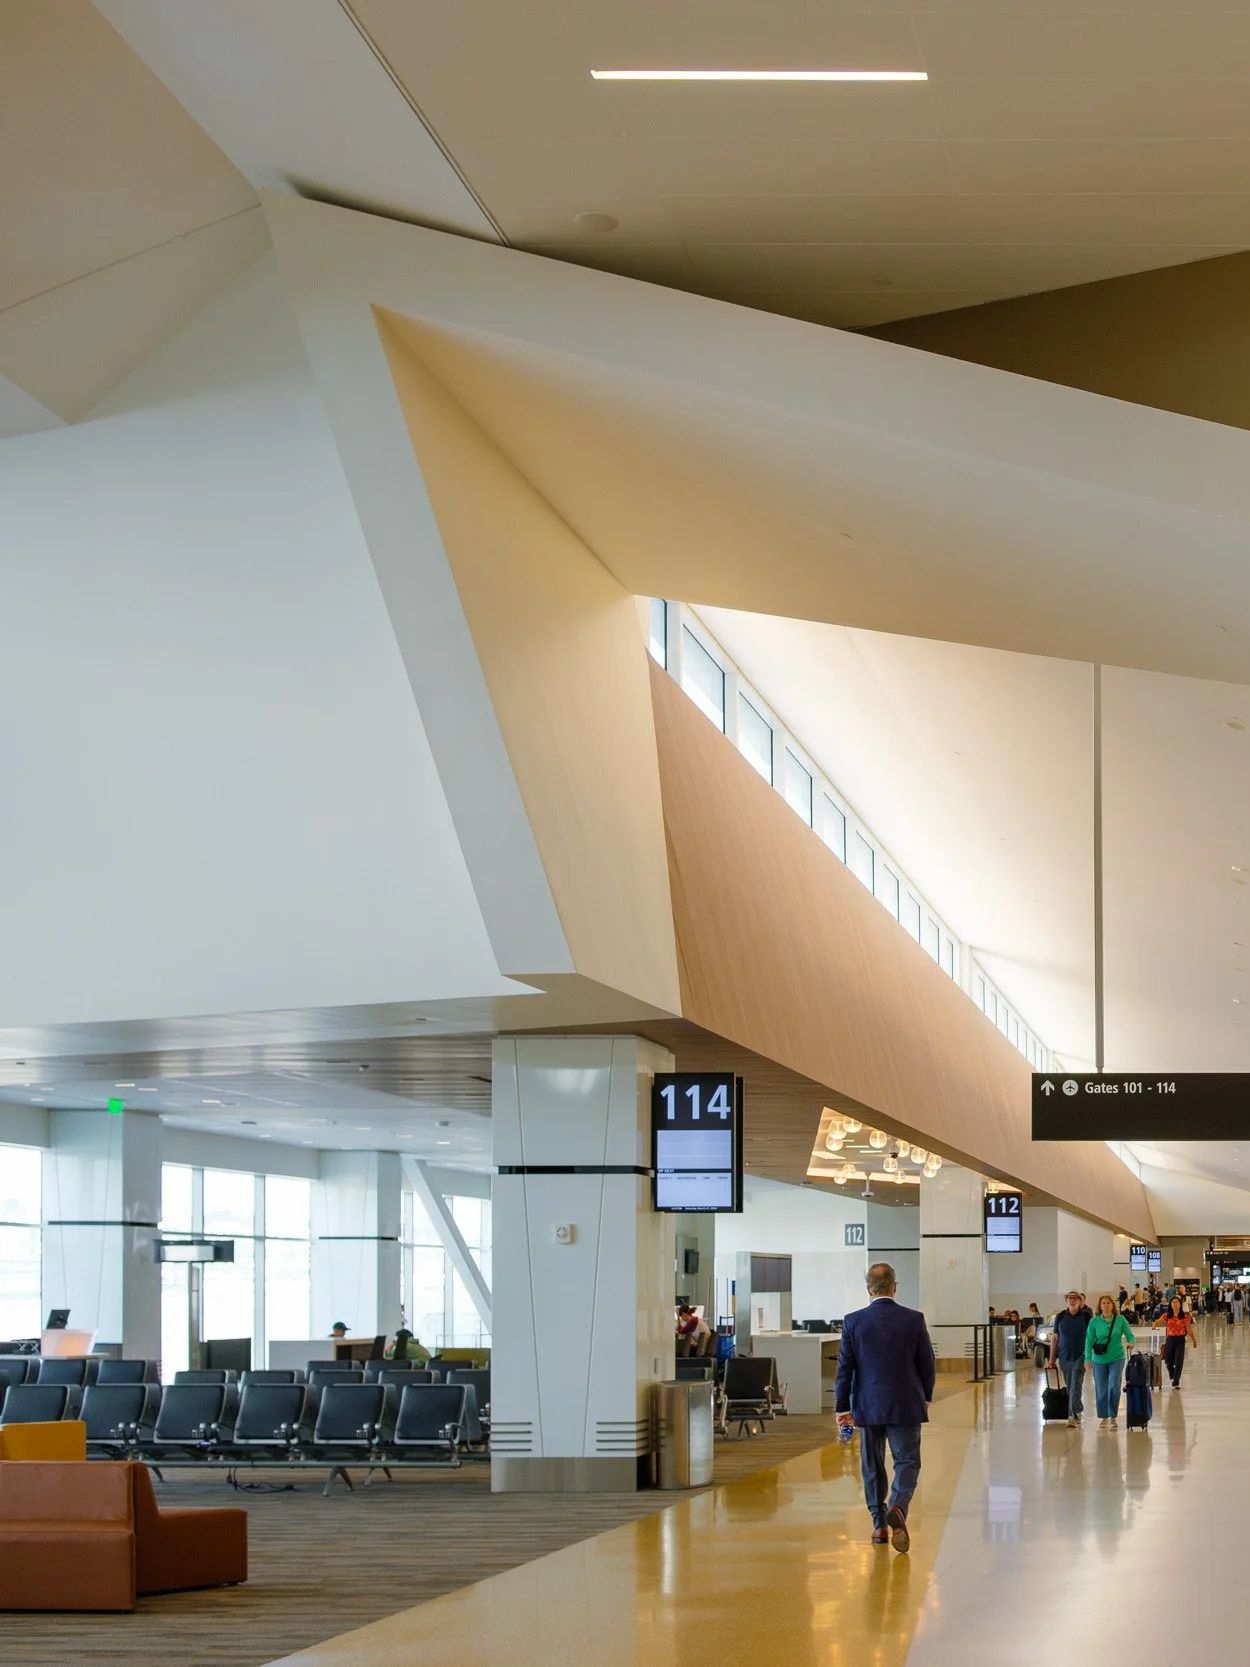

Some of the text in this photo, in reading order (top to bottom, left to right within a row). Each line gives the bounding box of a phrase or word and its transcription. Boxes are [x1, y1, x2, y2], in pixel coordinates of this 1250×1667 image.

[1084, 1081, 1119, 1094] Gates
[1123, 1081, 1142, 1094] 101
[1156, 1081, 1177, 1094] 114
[660, 1084, 731, 1120] 114
[988, 1197, 1019, 1213] 112
[847, 1227, 863, 1242] 112
